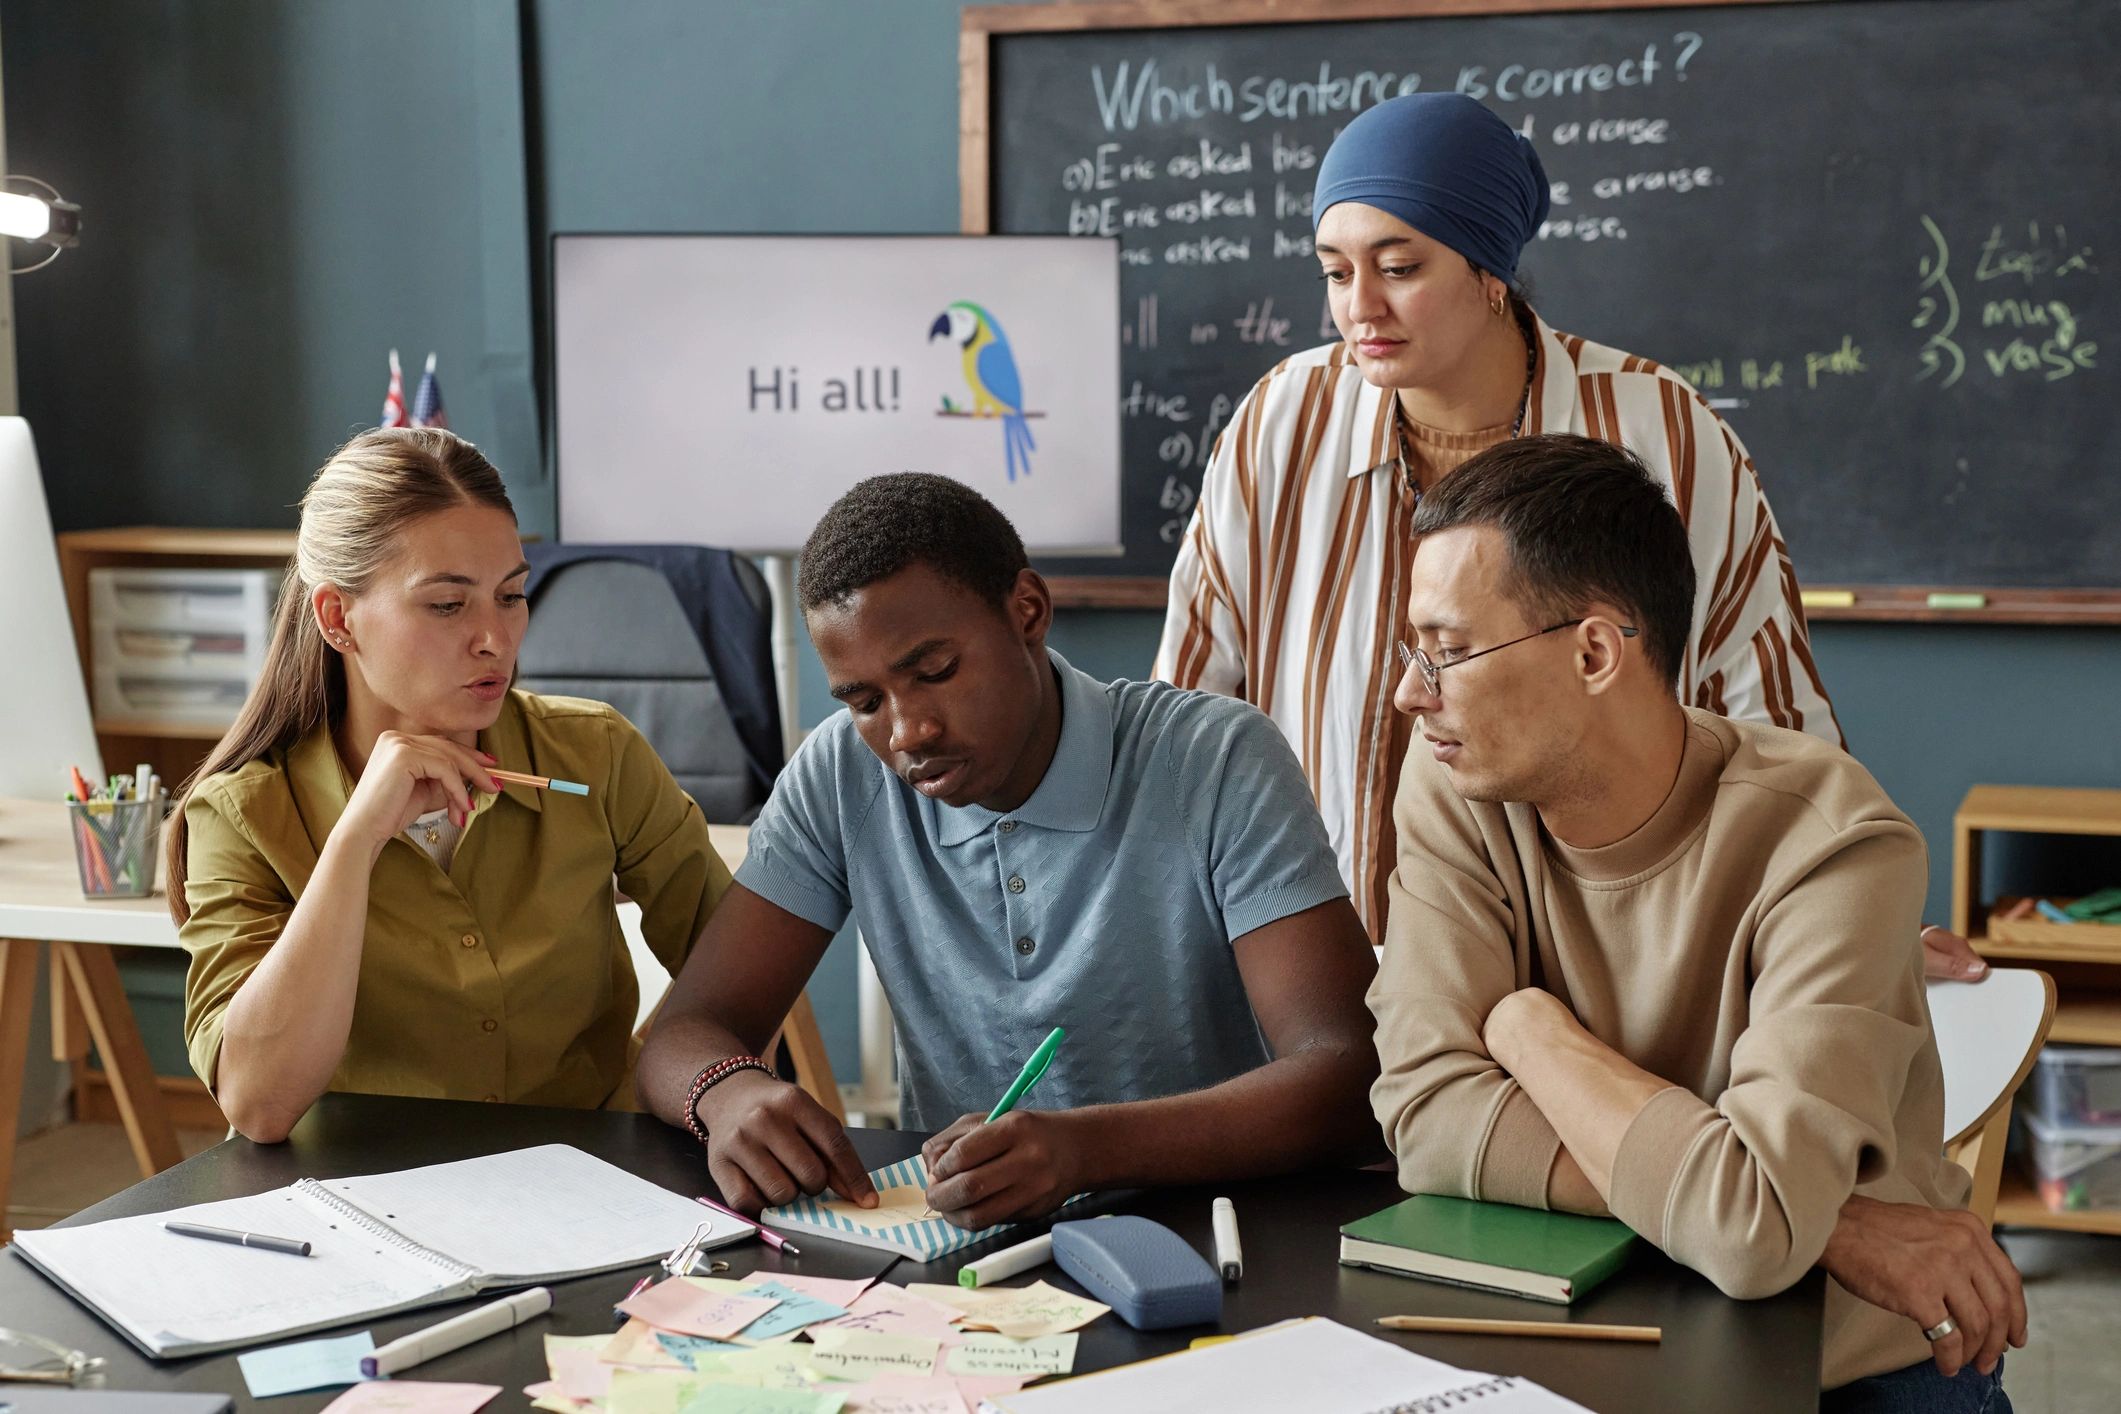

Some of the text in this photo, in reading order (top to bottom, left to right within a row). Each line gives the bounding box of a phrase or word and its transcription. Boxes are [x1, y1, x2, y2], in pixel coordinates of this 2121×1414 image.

[1091, 57, 1233, 132] Which
[1238, 59, 1421, 123] sentence
[1455, 65, 1489, 101] is
[1166, 138, 1252, 179] asked
[1272, 131, 1317, 174] his
[1164, 187, 1256, 221] asked
[1164, 235, 1250, 264] asked
[1273, 228, 1315, 259] his
[1190, 321, 1219, 345] in
[1233, 296, 1291, 347] the
[1982, 299, 2077, 351] mug
[1983, 337, 2098, 383] vase
[749, 366, 901, 413] Hi all!
[1159, 473, 1194, 514] b)
